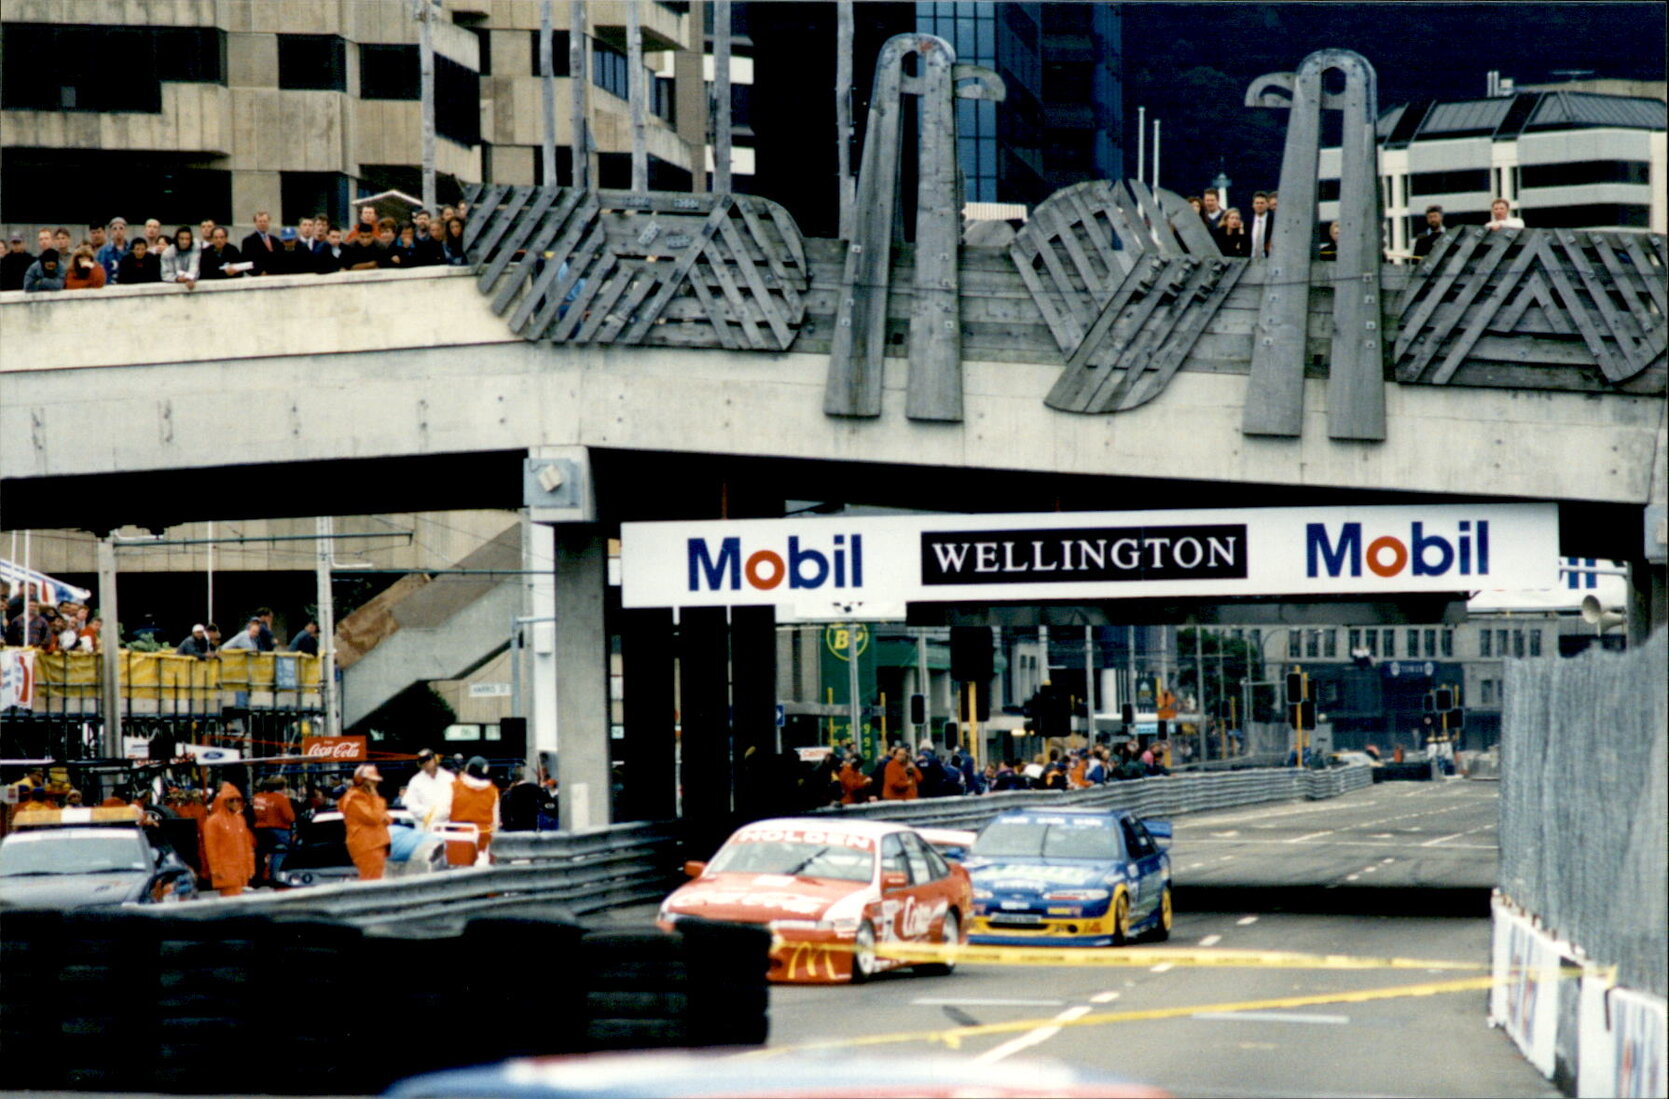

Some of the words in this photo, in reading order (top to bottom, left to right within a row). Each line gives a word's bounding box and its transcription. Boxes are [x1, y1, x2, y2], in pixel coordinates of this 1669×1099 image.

[687, 534, 863, 591] Mobil
[931, 536, 1237, 573] WELLINGTON
[1305, 519, 1490, 578] Mobil
[308, 742, 361, 758] Coca-Cola
[739, 830, 870, 849] HOLDEN
